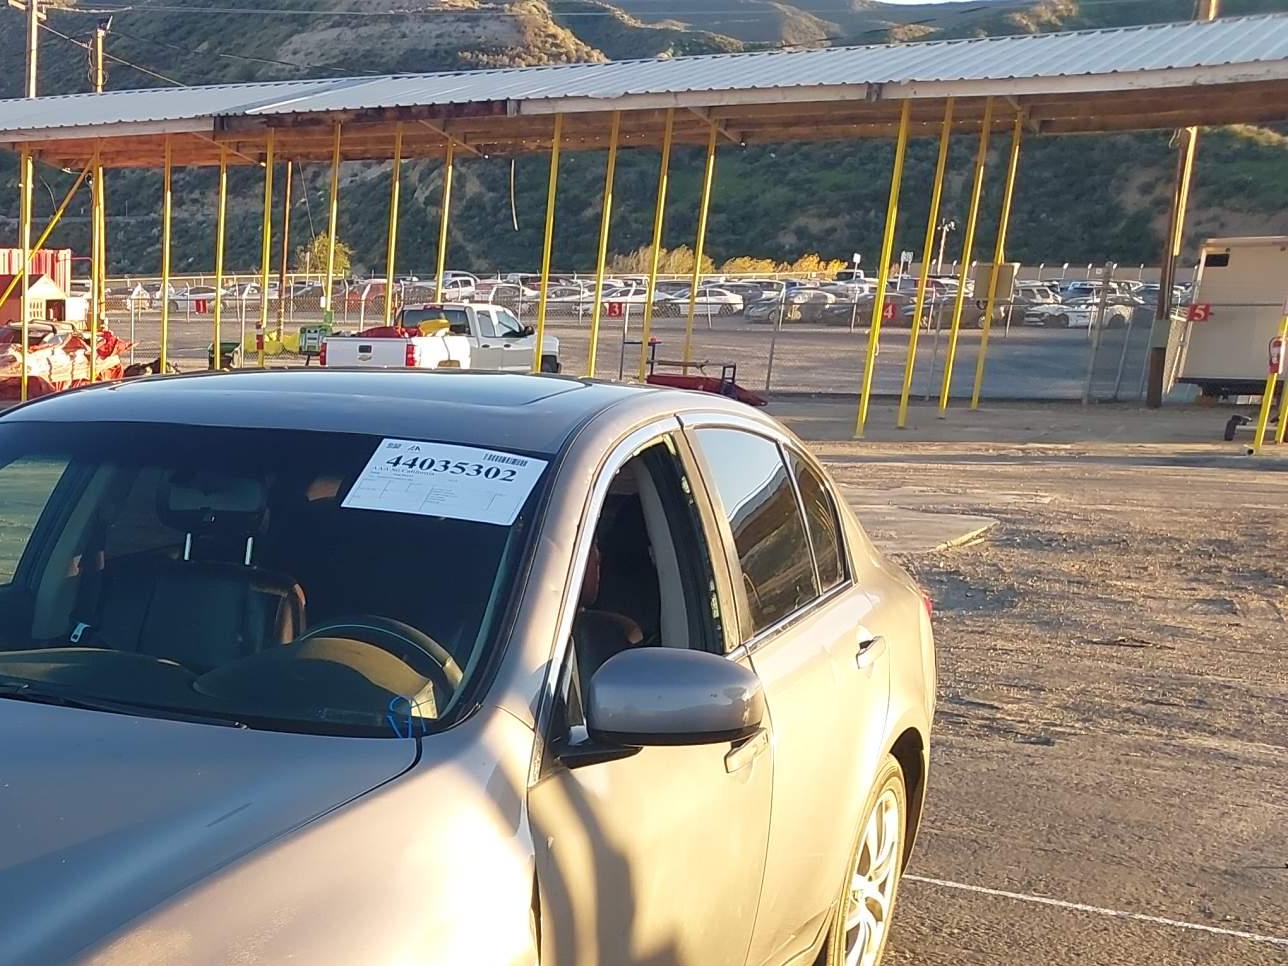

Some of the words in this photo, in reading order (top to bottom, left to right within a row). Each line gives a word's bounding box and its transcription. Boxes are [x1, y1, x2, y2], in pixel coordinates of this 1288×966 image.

[611, 303, 619, 316] 3
[883, 304, 893, 319] 4
[1194, 304, 1206, 320] 5
[385, 455, 517, 482] 44035302
